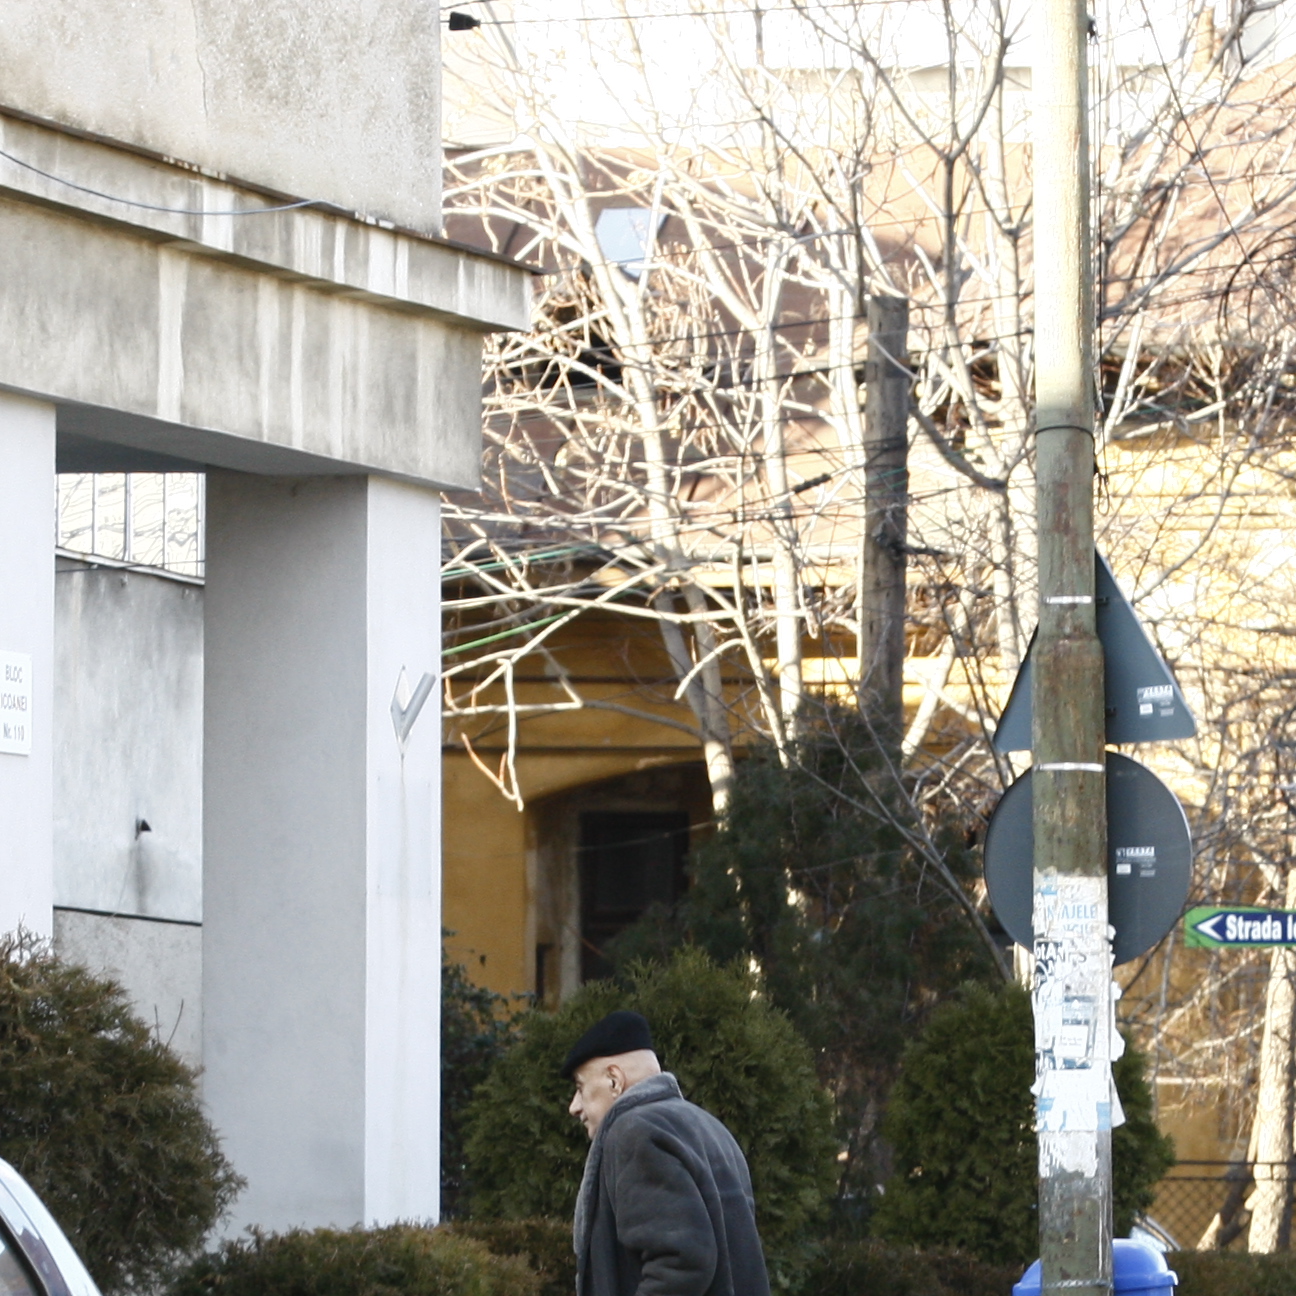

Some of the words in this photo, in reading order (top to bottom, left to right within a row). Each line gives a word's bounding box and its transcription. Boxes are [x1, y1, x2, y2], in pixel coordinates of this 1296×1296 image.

[5, 664, 23, 683] BLOC
[0, 693, 27, 711] ICOANEI
[1225, 914, 1282, 941] Strada
